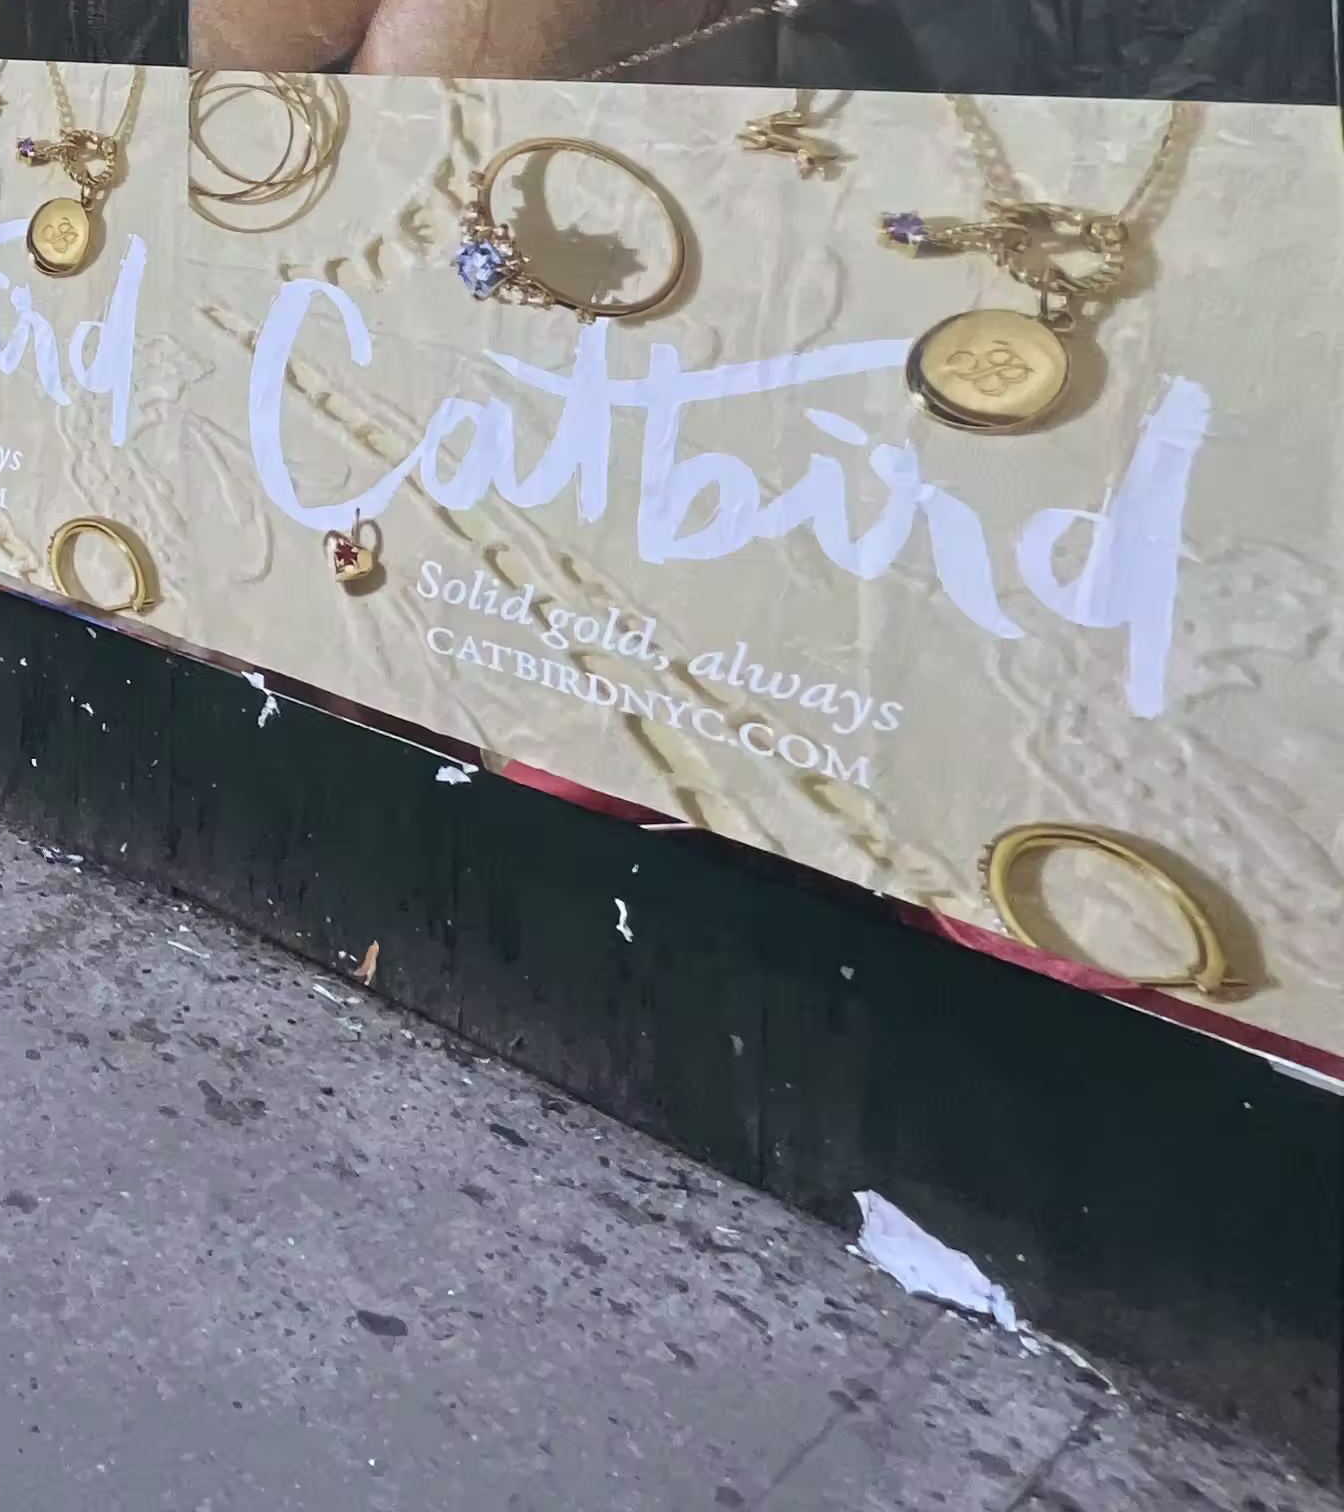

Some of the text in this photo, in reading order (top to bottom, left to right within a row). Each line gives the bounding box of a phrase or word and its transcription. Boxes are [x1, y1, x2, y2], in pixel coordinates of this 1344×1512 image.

[248, 278, 1214, 720] Catbird
[415, 559, 906, 735] Solid gold, always
[426, 625, 873, 790] CATBIRDNYC.COM
